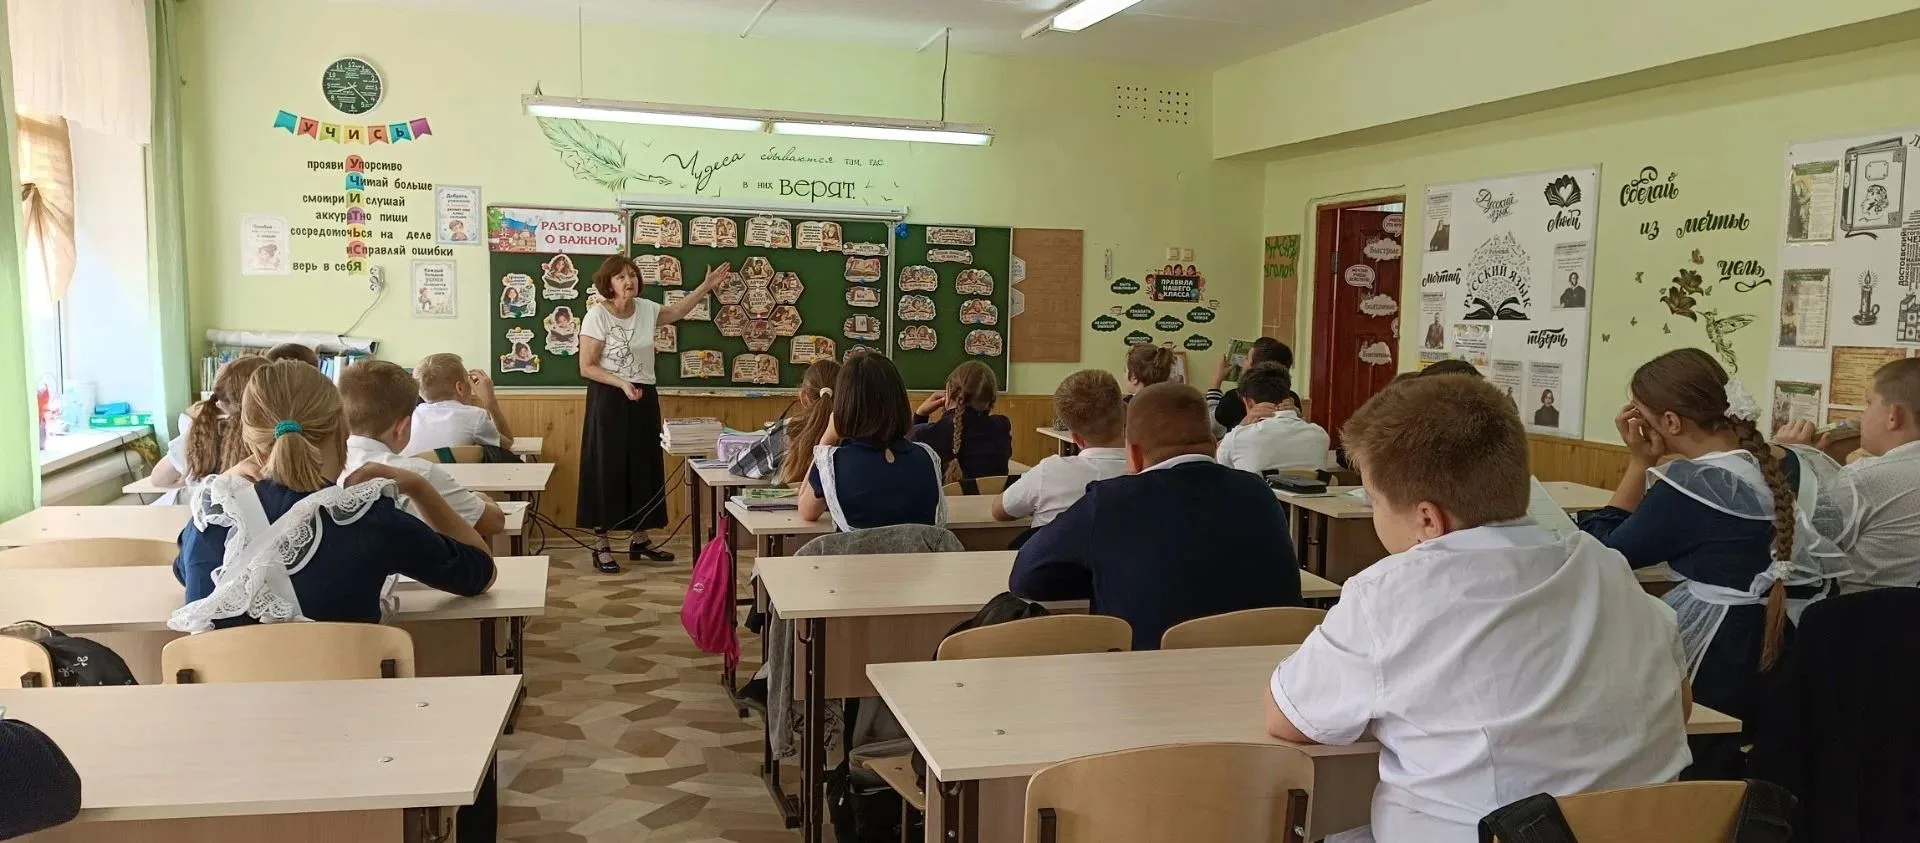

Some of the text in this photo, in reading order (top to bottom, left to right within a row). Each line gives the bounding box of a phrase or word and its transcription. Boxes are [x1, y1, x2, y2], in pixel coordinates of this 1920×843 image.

[304, 122, 404, 140] УЧИСЬ
[307, 158, 403, 172] прояви Упорство
[662, 150, 745, 194] Чудеса
[760, 146, 833, 163] сбываются
[869, 158, 884, 166] где
[350, 174, 433, 191] Читай больше
[742, 181, 749, 189] в
[1620, 166, 1679, 207] Сделай
[303, 194, 345, 205] смотри
[365, 196, 405, 208] слушай
[1475, 188, 1515, 213] Русский
[380, 213, 408, 223] пиши
[1547, 209, 1581, 232] Люби
[1640, 209, 1750, 240] из мечты
[381, 230, 393, 239] на
[406, 230, 432, 240] деле
[541, 221, 622, 233] РАЗГОВОРЫ
[545, 234, 618, 246] О ВАЖНОМ
[412, 245, 453, 256] ошибки
[293, 261, 318, 272] верь
[323, 262, 330, 271] в
[1717, 260, 1767, 285] цель
[1463, 263, 1508, 309] РУССКИЙ
[1509, 270, 1532, 309] ЯЗЫК
[1527, 327, 1568, 349] твори
